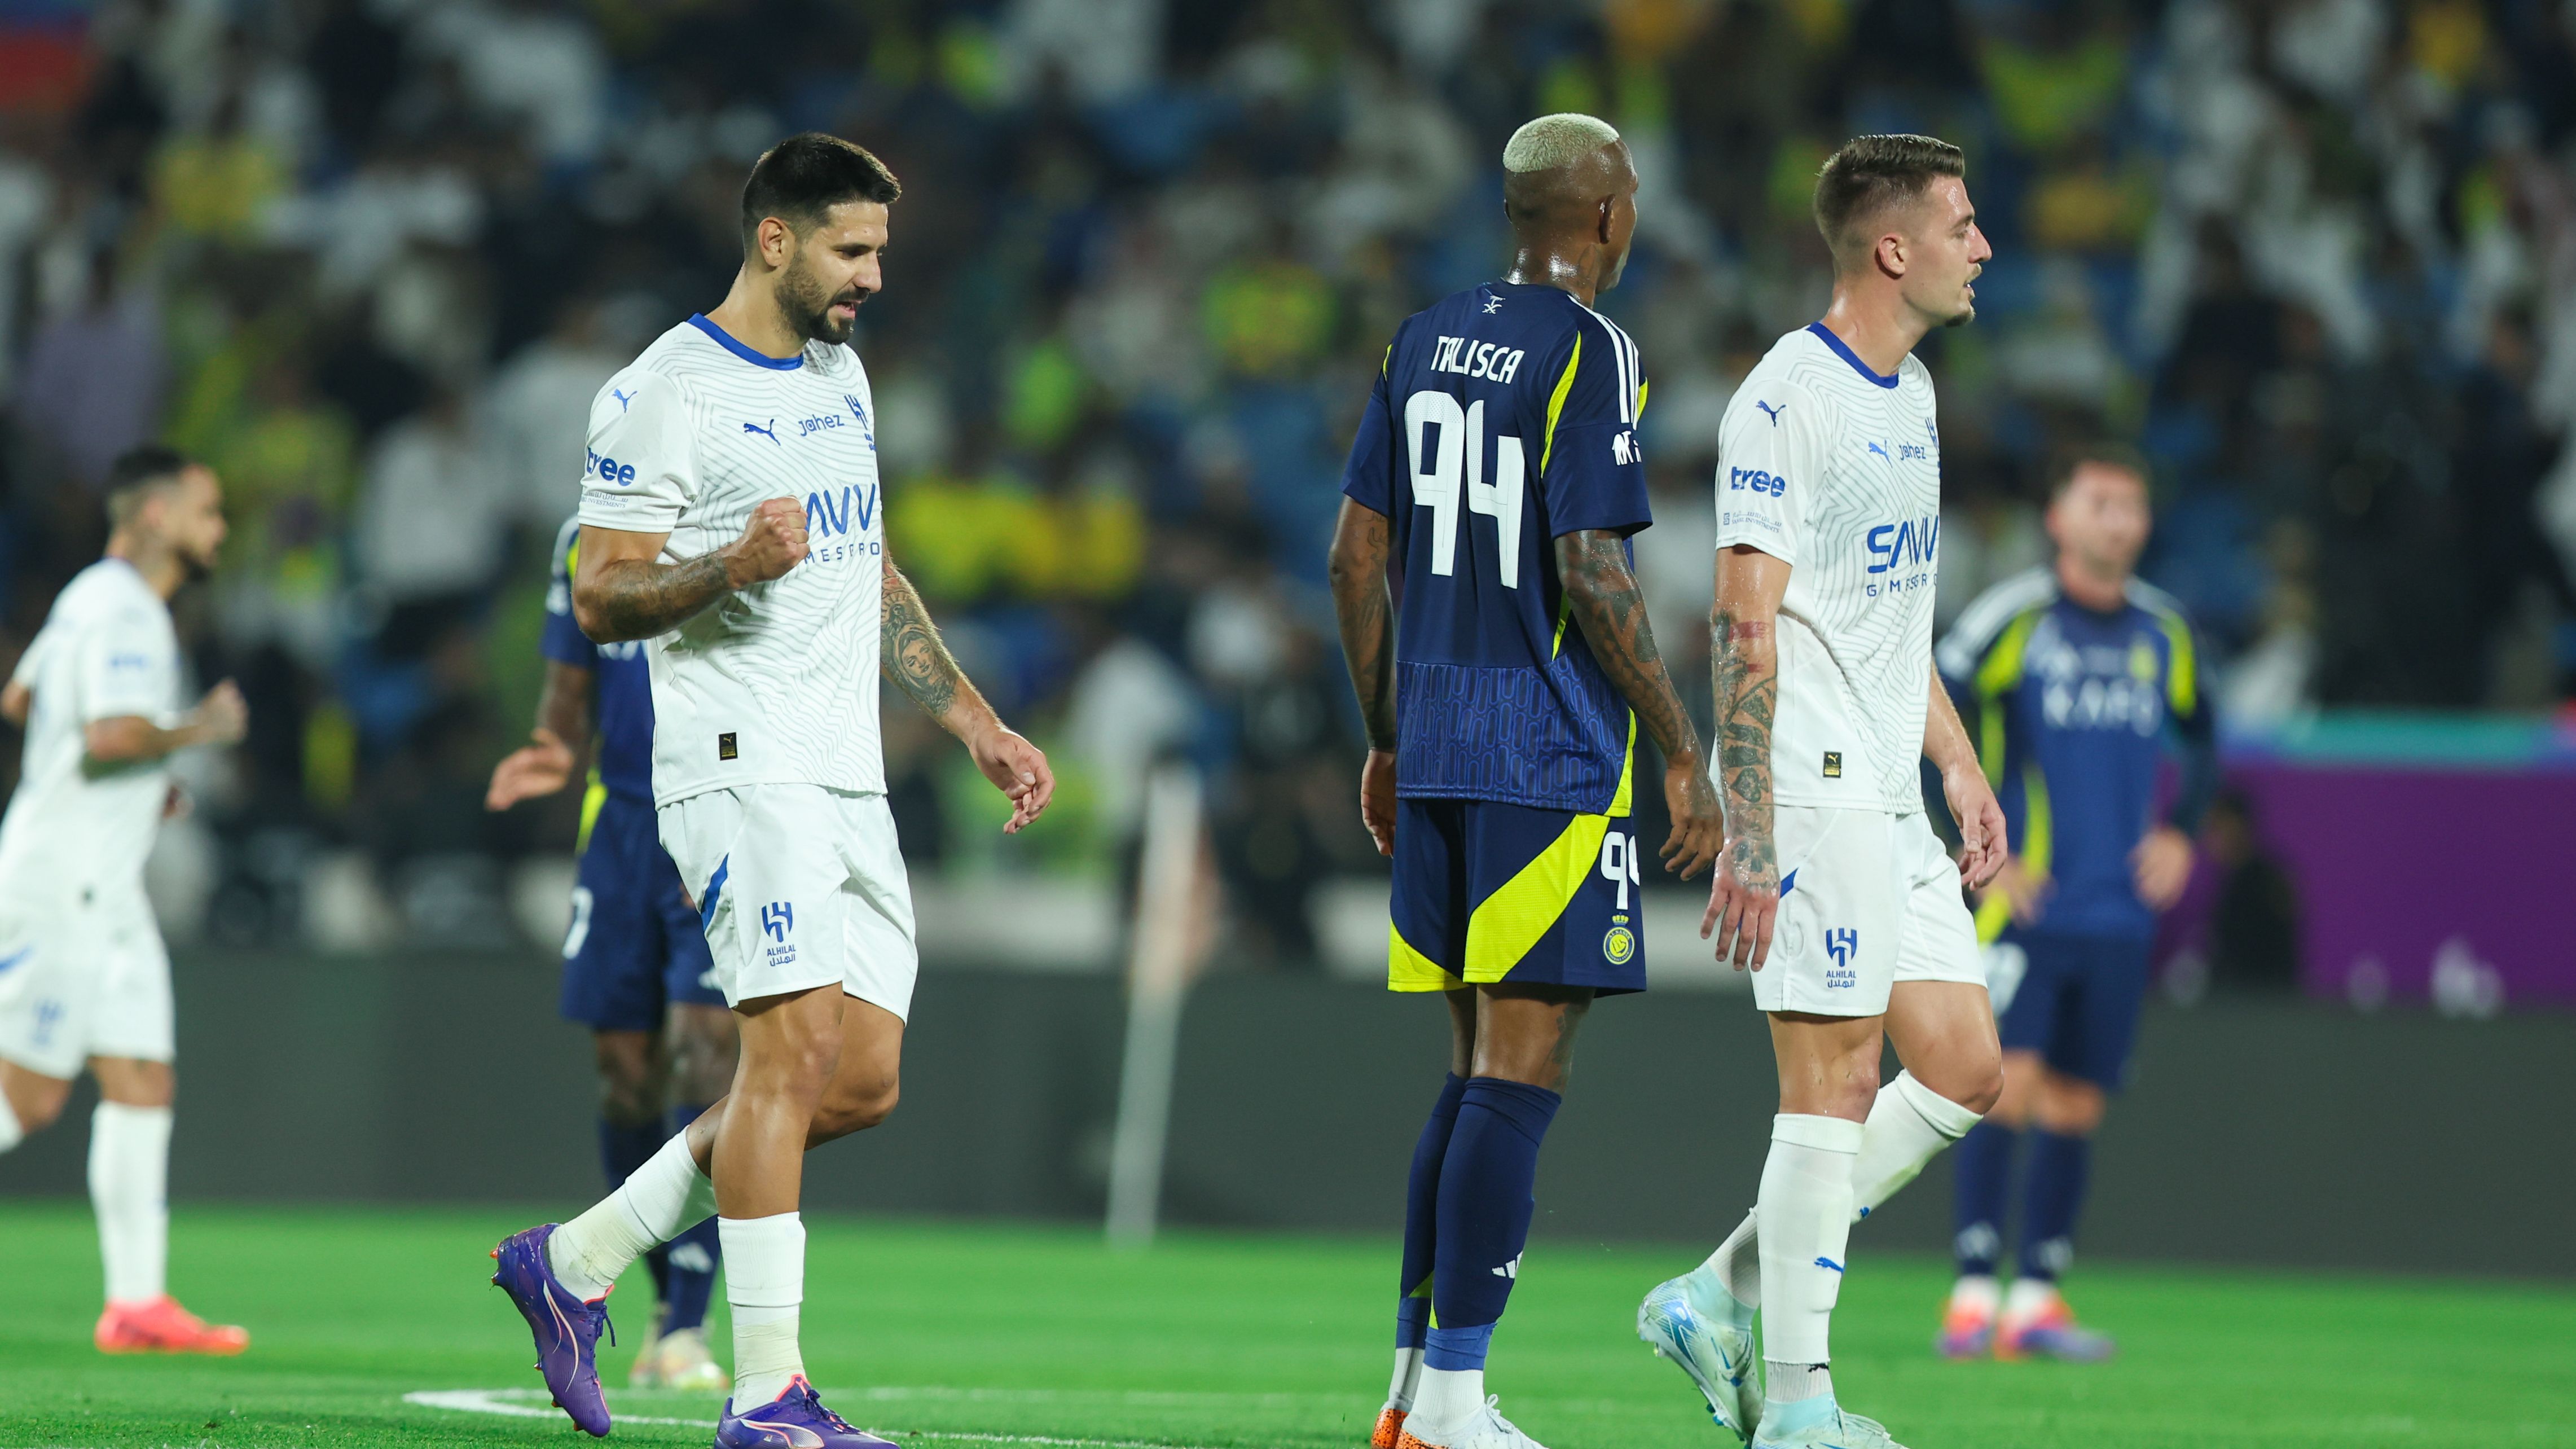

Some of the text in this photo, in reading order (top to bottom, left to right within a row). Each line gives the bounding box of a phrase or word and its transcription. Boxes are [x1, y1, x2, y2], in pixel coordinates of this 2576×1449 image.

[1430, 336, 1525, 384] TALISCA
[798, 414, 845, 437] jahez
[587, 447, 635, 486] tree
[1899, 441, 1926, 460] jahez
[1404, 390, 1525, 589] 94
[1731, 466, 1786, 497] tree
[805, 483, 876, 538] AVV
[1867, 515, 1938, 573] SAVV
